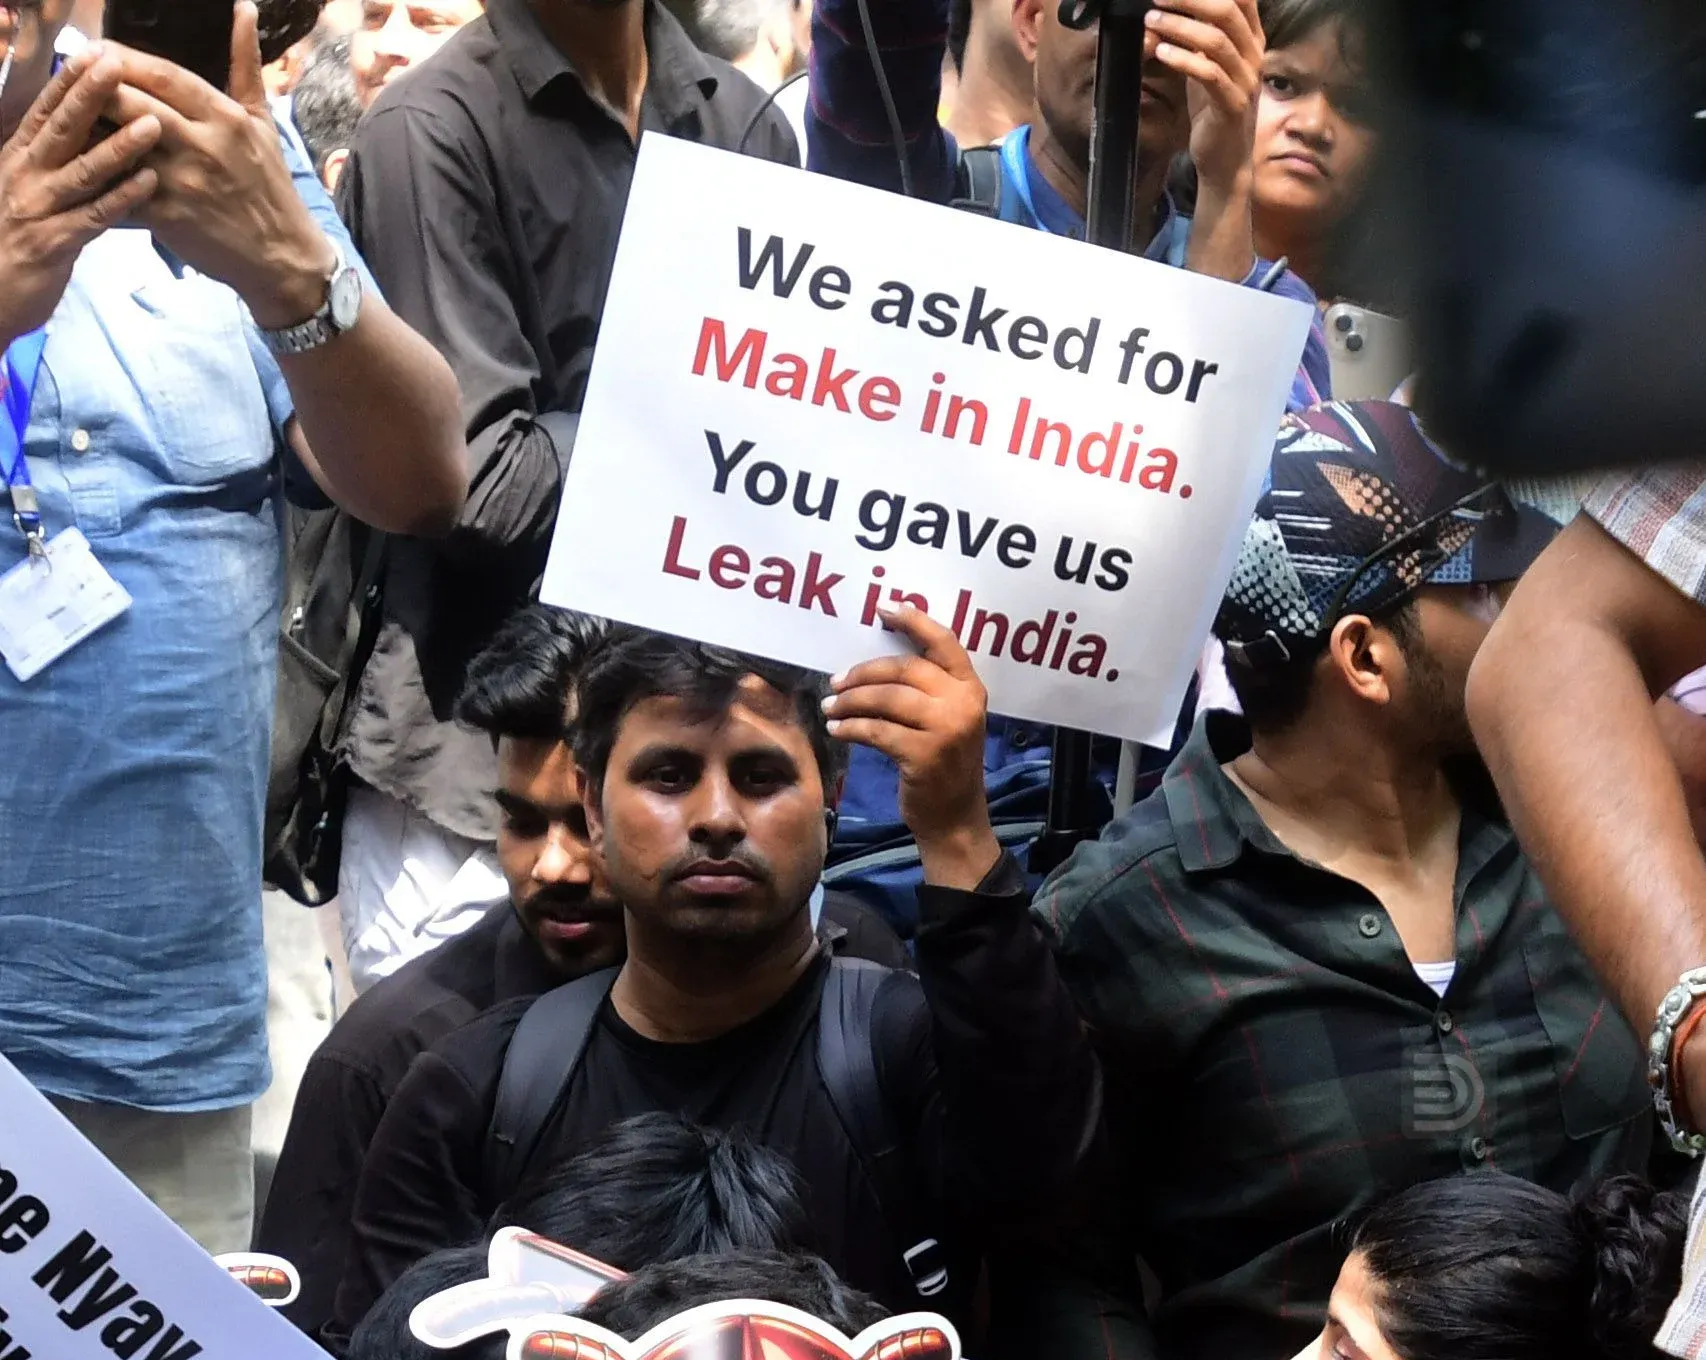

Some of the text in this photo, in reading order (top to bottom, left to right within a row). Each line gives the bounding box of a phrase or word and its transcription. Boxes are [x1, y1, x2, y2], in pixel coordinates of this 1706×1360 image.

[737, 226, 1219, 404] We asked for
[691, 317, 1193, 499] Make in India.
[704, 429, 1133, 592] You gave us
[662, 515, 846, 618] Leak
[951, 588, 1120, 683] India.
